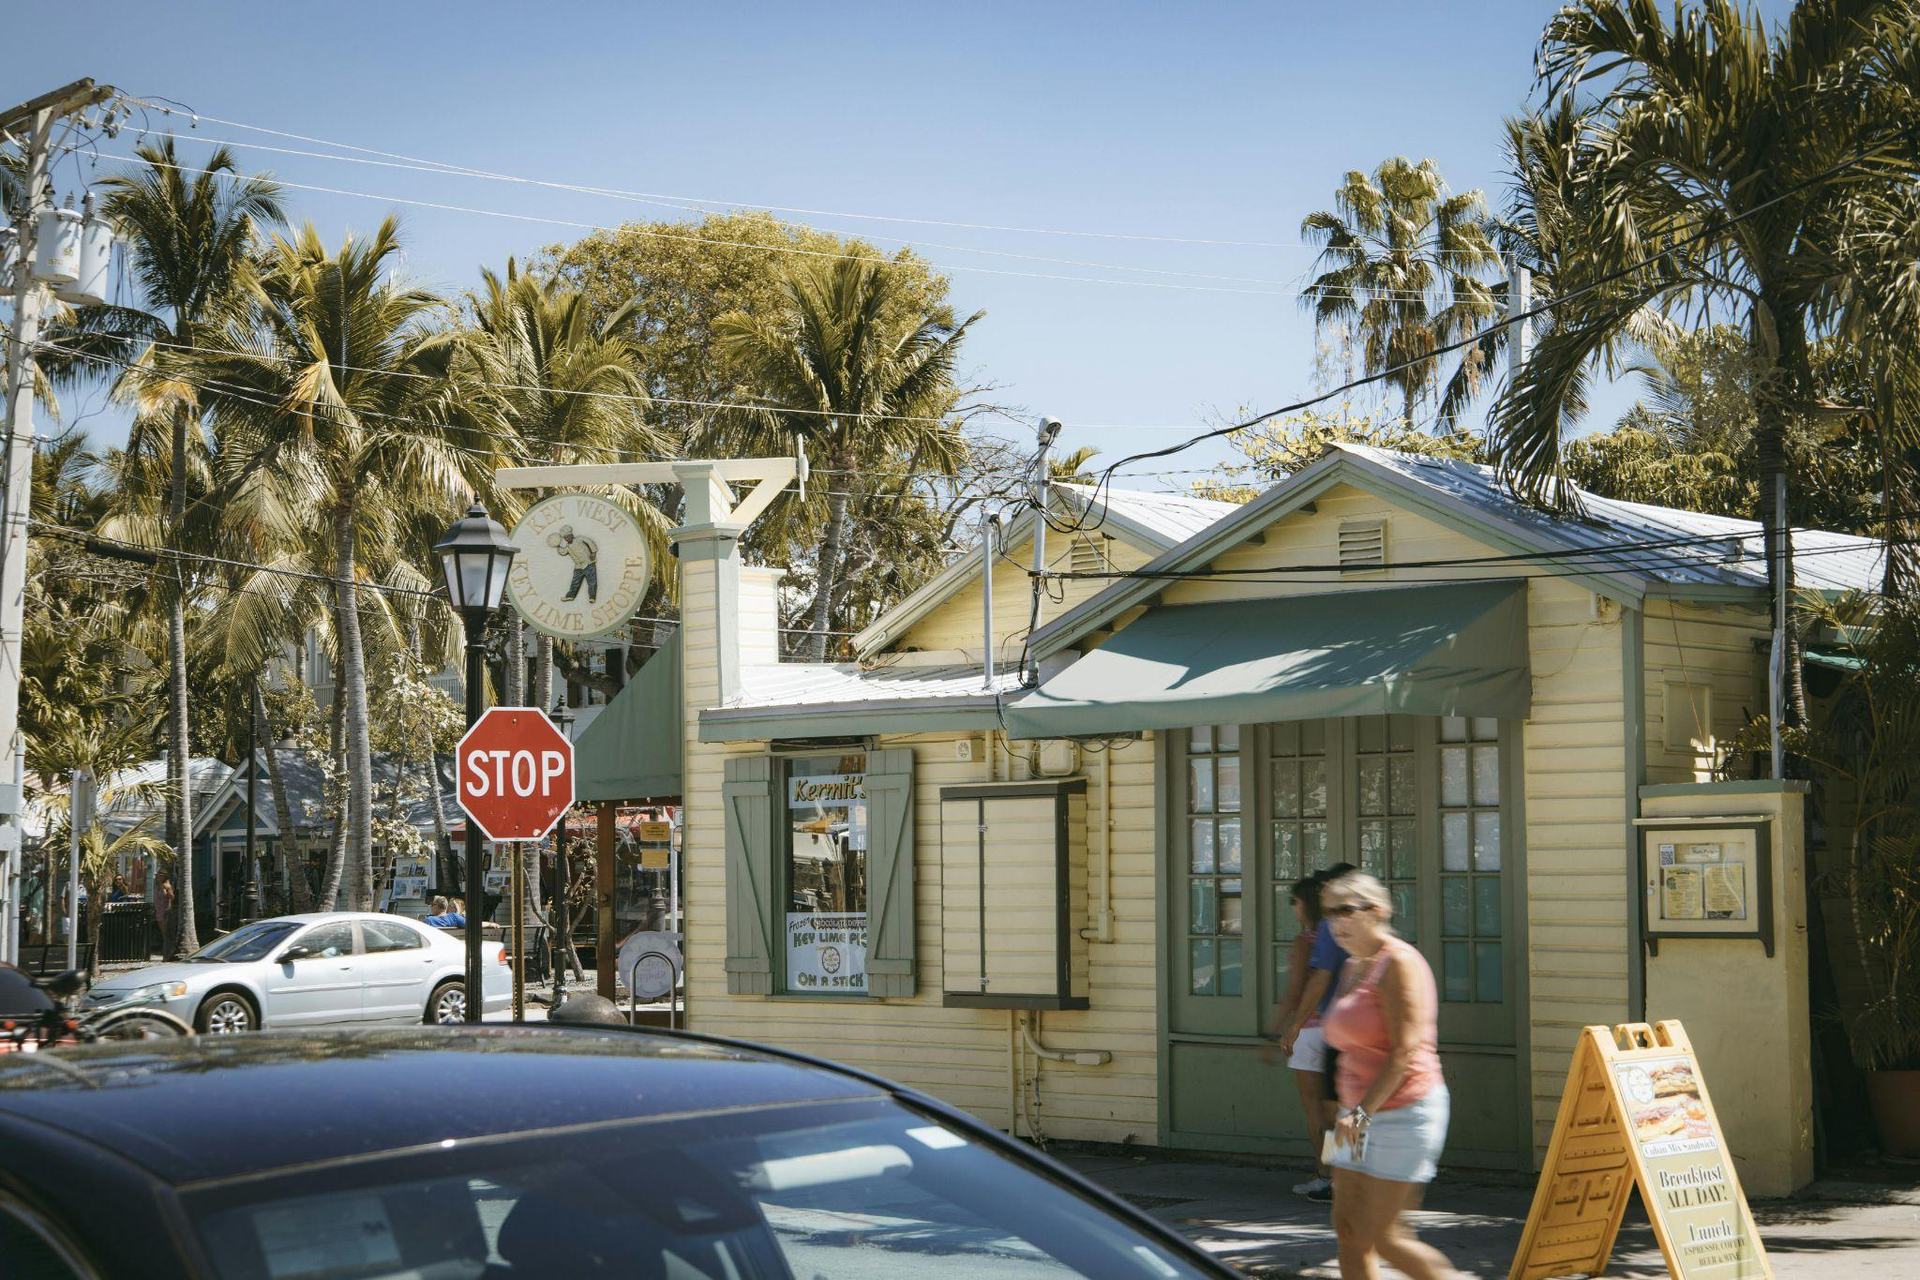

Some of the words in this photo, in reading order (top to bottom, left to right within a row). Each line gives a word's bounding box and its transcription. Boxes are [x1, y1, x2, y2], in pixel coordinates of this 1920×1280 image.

[526, 500, 565, 535] KEY
[575, 499, 627, 533] WEST
[511, 559, 538, 600] KEY
[532, 601, 584, 631] LIME
[590, 557, 643, 629] SHOPPE
[466, 750, 565, 797] STOP
[794, 775, 867, 802] Kermit's
[788, 917, 810, 933] Frozen
[793, 932, 816, 948] KEY
[819, 932, 846, 943] LIME
[798, 972, 817, 986] ON
[821, 976, 829, 987] A
[832, 972, 864, 987] STICK
[1659, 1164, 1723, 1188] Breakfast
[1668, 1187, 1695, 1209] ALL
[1696, 1184, 1728, 1205] DAY!
[1689, 1219, 1732, 1241] Lunch
